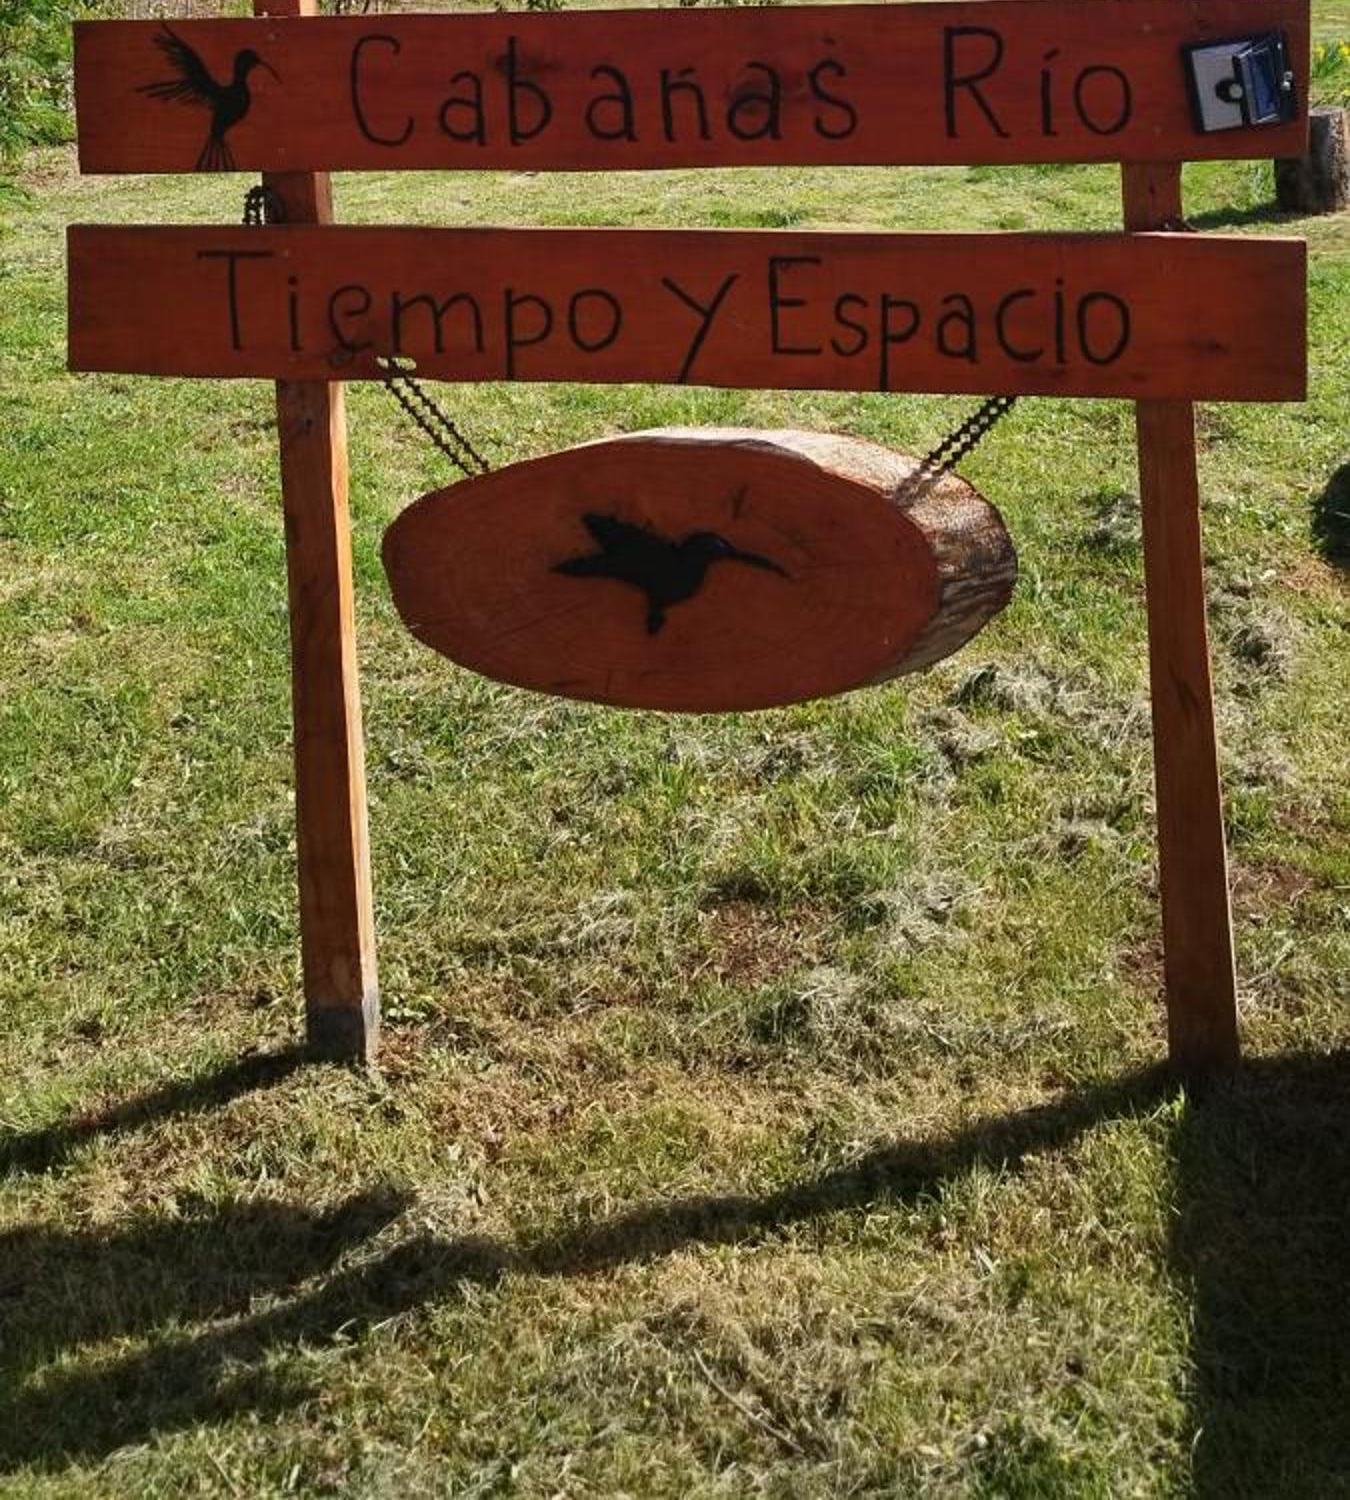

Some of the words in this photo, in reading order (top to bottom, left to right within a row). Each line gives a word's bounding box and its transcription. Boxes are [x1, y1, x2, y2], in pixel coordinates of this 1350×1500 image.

[942, 26, 1132, 138] Río
[198, 250, 622, 380] Tiempo
[768, 255, 1131, 391] Espacio
